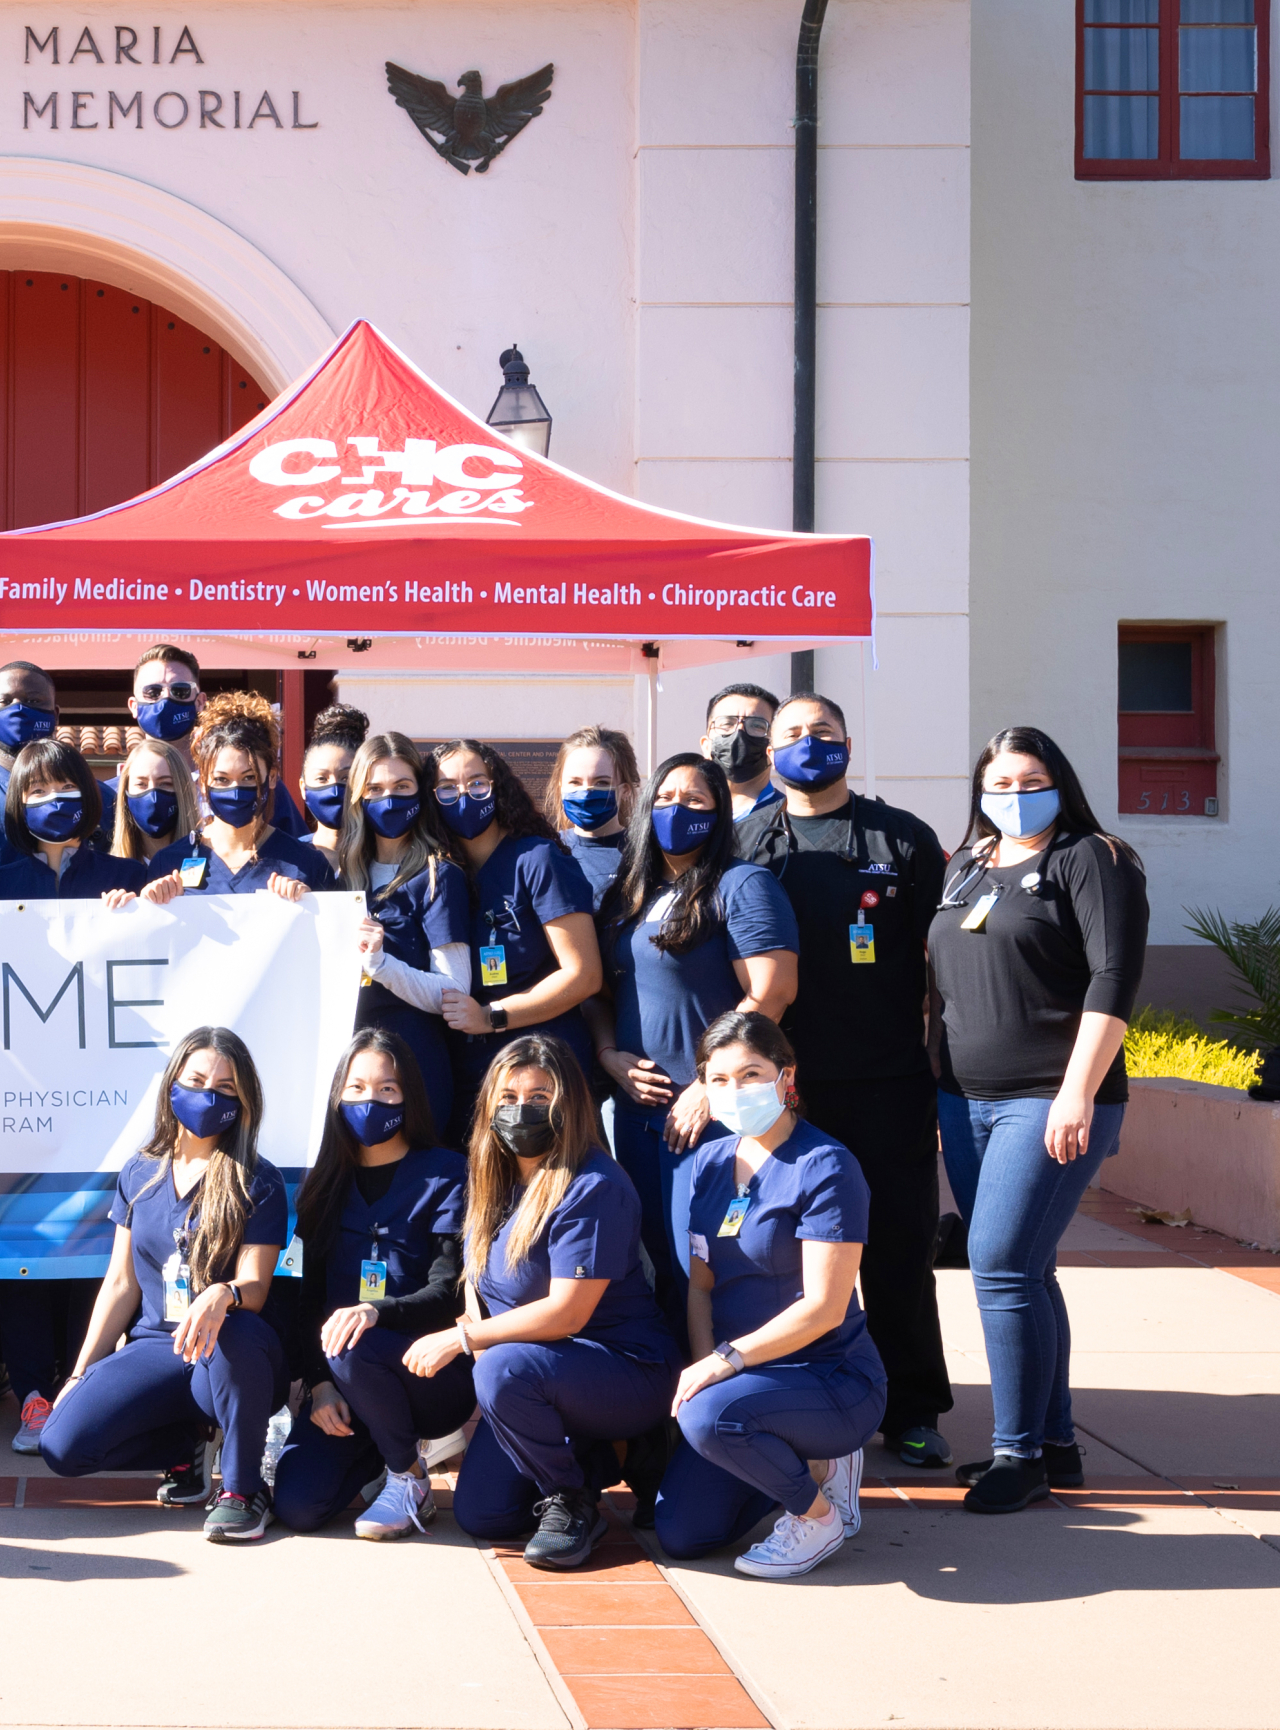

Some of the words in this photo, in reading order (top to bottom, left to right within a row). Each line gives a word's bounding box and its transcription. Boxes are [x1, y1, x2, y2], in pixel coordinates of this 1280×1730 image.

[23, 25, 205, 65] MARIA
[22, 89, 320, 130] MEMORIAL
[248, 436, 524, 490] CHC
[272, 486, 535, 520] cares
[73, 577, 169, 601] Medicine
[189, 578, 286, 607] Dentistry
[305, 579, 399, 603] Women's
[404, 580, 474, 603] Health
[493, 581, 566, 605] Mental
[573, 582, 642, 605] Health
[661, 582, 787, 611] Chiropractic
[791, 584, 837, 608] Care
[173, 711, 190, 721] ATSU
[34, 720, 51, 729] ATSU
[826, 752, 844, 762] ATSU
[1136, 790, 1190, 811] 513
[480, 801, 495, 816] ATSU
[687, 822, 710, 833] ATSU
[868, 863, 891, 872] ATSU
[4, 1089, 129, 1108] PHYSICIAN
[222, 1110, 237, 1121] ATSU
[384, 1114, 403, 1128] ATSU
